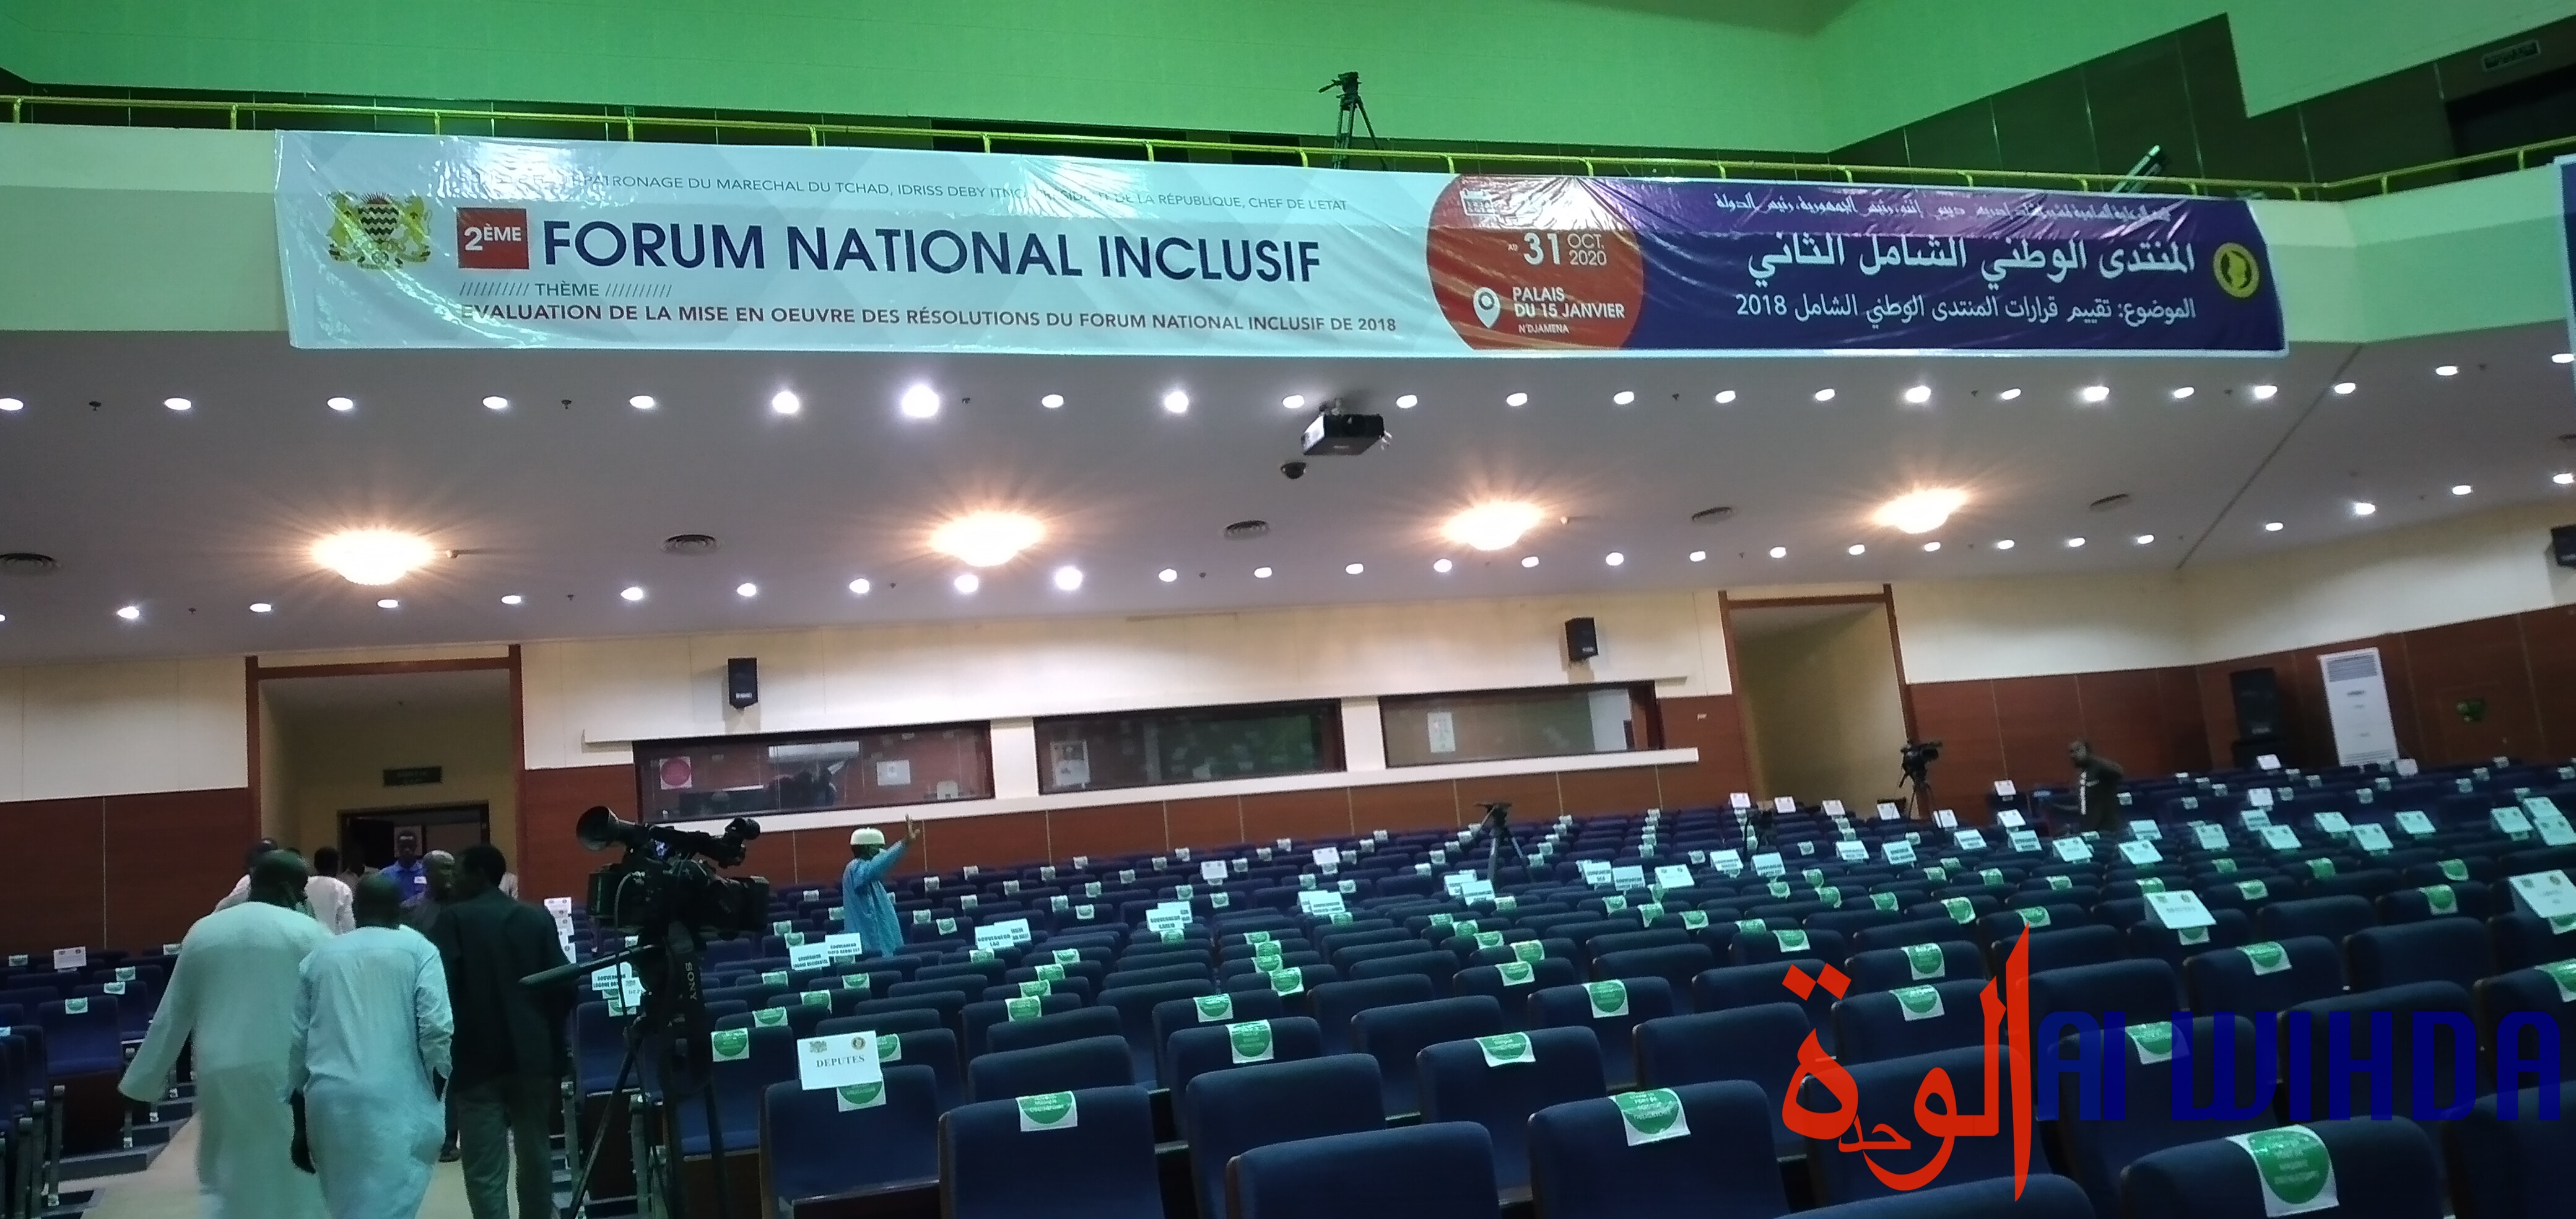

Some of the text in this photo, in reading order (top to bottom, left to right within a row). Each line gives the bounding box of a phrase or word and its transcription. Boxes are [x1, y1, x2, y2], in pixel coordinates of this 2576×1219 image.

[688, 177, 710, 189] DU
[716, 178, 804, 192] MARECHAL
[808, 181, 830, 193] DU
[835, 181, 893, 196] TCHAD,
[898, 184, 944, 196] IDRISS
[948, 186, 985, 198] DEBY
[1138, 193, 1154, 205] LA
[1159, 193, 1245, 209] RÉPUBLIQUE,
[1248, 198, 1283, 209] CHEF
[1287, 198, 1305, 209] DE
[1308, 199, 1347, 211] L'ETAT
[464, 222, 521, 251] 2ÈME
[1523, 232, 1561, 265] 31
[1567, 233, 1605, 249] OCT.
[543, 220, 1320, 283] FORUM NATIONAL INCLUSIF
[1569, 250, 1607, 266] 2020
[1748, 232, 2195, 291] المنتدى الوطني الشامل الثاني
[536, 279, 599, 297] THÈME
[1513, 287, 1565, 302] PALAIS
[461, 304, 1397, 331] EVALUATION DE LA MISE EN OEUVRE DES RÉSOLUTIONS DU FORUM NATIONAL INCLUSIF DE 2018
[1515, 302, 1625, 318] DU 15 JANVIER
[1735, 293, 2196, 330] الموضوع: تقييم قرارات المنتدى الوطني الشامل 2018
[1518, 323, 1570, 334] N'DJAMENA
[685, 961, 697, 1001] SONY
[816, 1054, 865, 1068] DEPUTES
